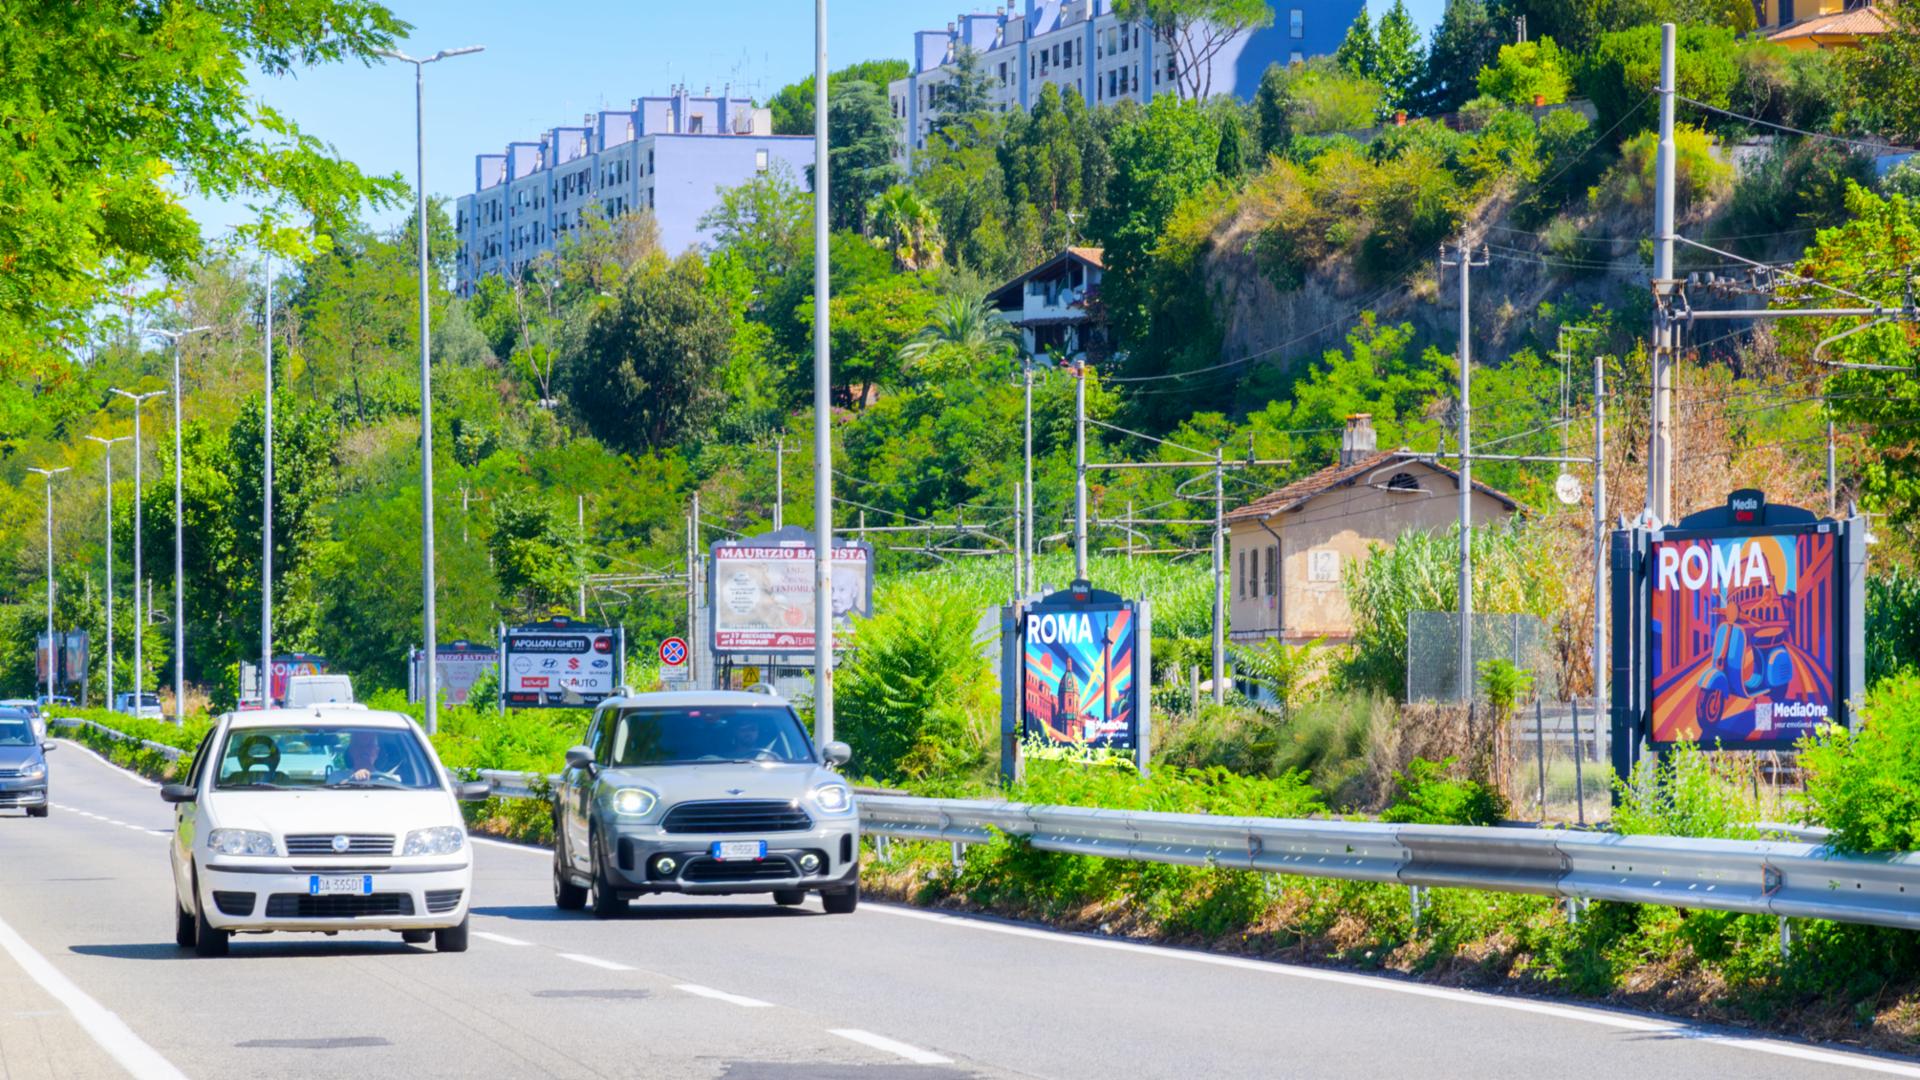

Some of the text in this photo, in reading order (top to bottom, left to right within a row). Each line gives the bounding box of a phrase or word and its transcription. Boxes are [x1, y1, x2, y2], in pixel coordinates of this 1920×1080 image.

[1732, 499, 1758, 510] Media
[720, 548, 866, 560] MAURIZIO BAISTA
[1658, 541, 1770, 591] ROMA
[1028, 613, 1094, 644] ROMA
[271, 663, 311, 677] OMA
[1774, 702, 1828, 717] MediaOne
